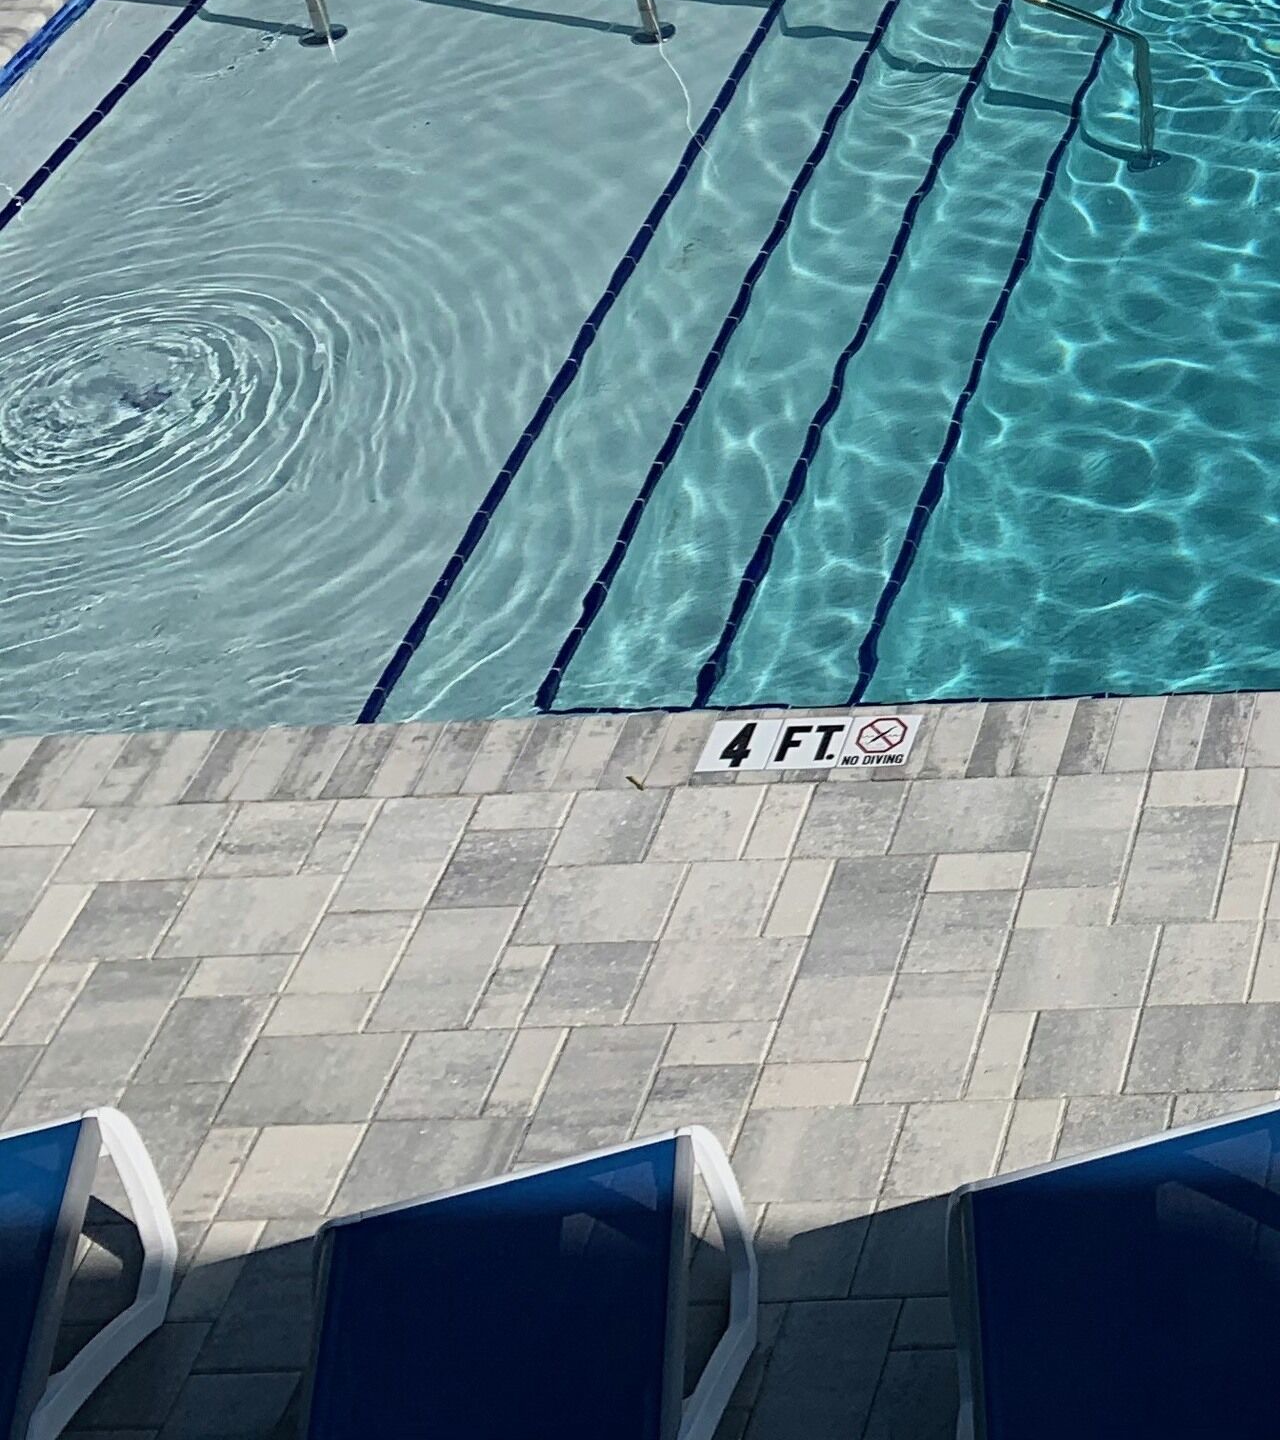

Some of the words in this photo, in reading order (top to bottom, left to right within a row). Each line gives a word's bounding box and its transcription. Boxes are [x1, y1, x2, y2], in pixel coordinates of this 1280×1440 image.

[719, 722, 758, 768] 4
[773, 725, 846, 763] FT.
[840, 754, 858, 766] NO
[862, 753, 905, 766] DIVING
